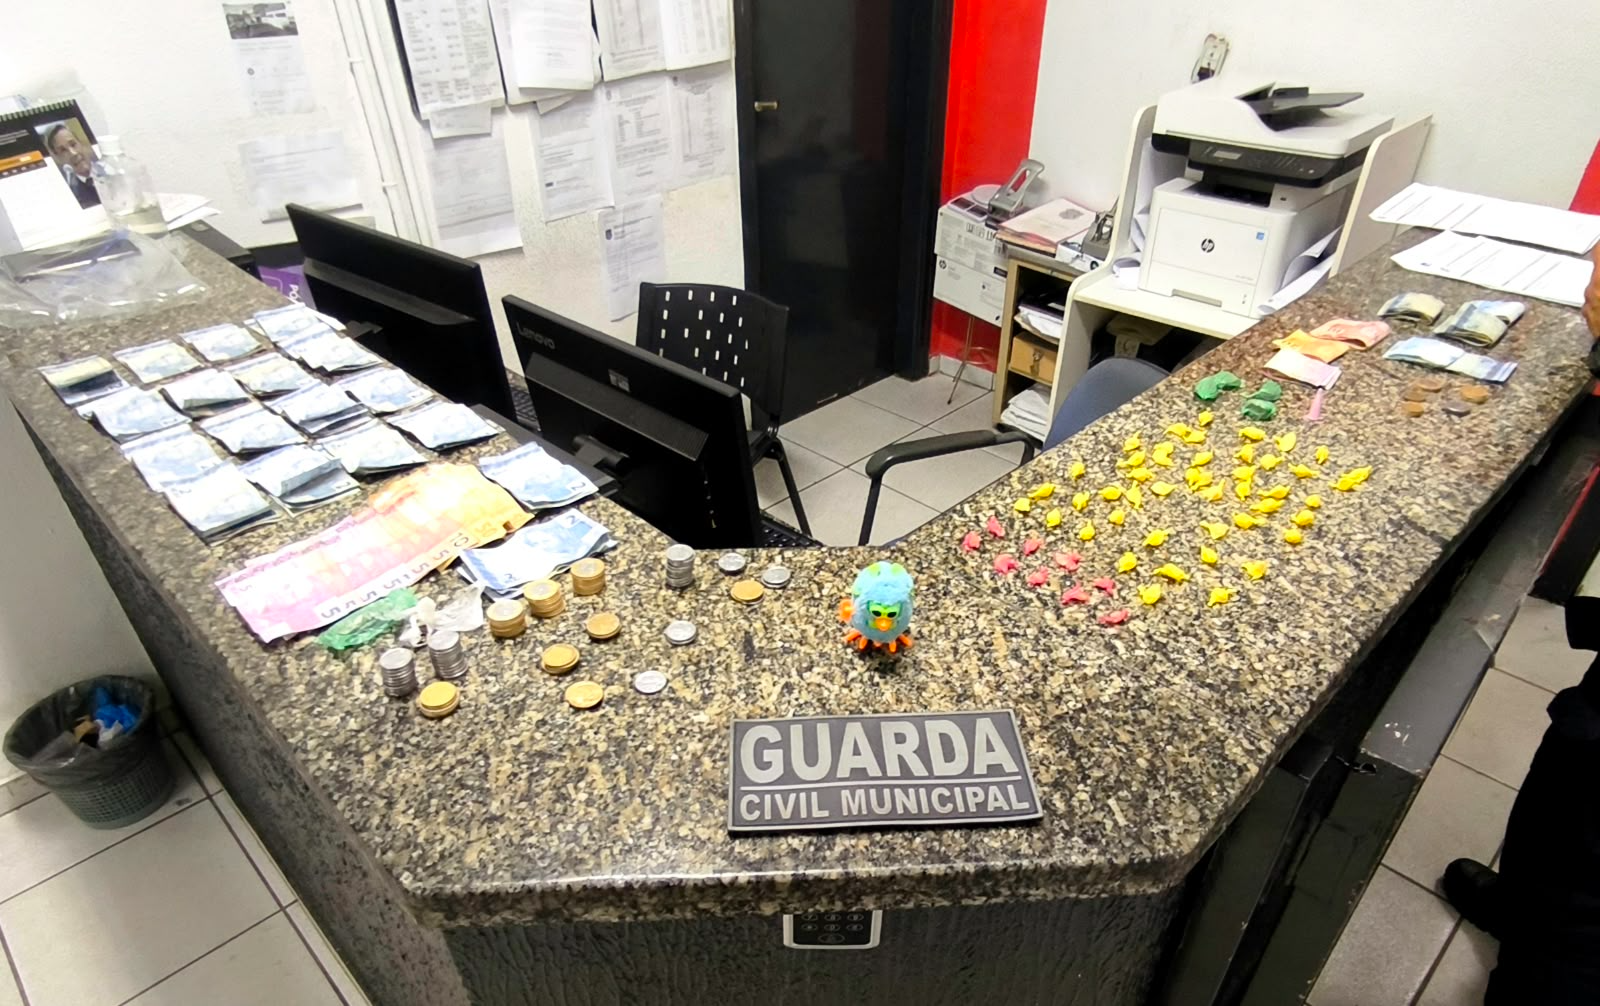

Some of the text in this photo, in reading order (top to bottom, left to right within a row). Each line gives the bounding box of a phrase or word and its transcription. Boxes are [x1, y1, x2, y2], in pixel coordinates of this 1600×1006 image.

[449, 531, 470, 548] 10
[320, 606, 342, 619] 5
[740, 717, 1020, 784] GUARDA
[739, 784, 1031, 821] CIVIL MUNICIPAL
